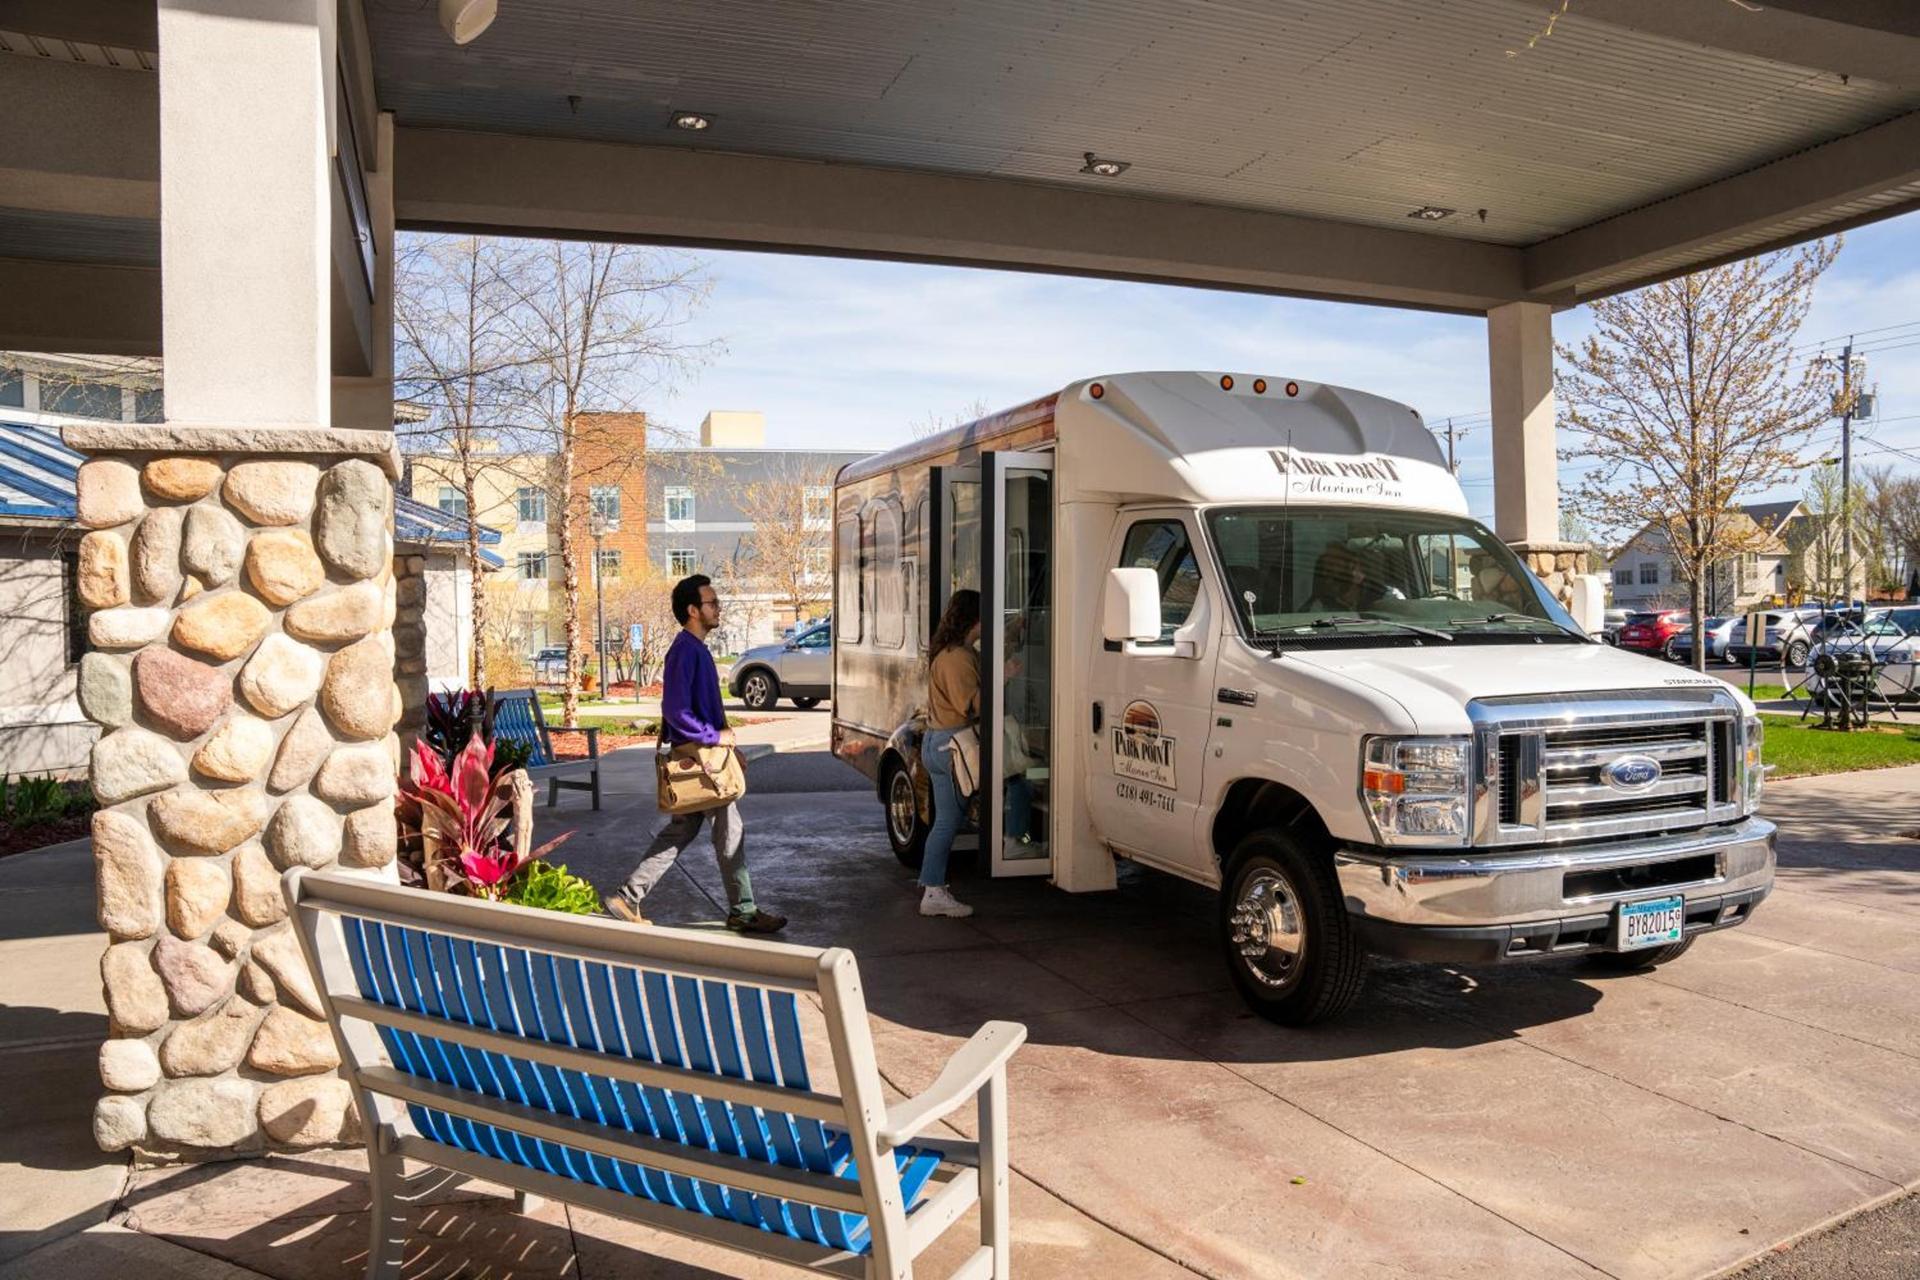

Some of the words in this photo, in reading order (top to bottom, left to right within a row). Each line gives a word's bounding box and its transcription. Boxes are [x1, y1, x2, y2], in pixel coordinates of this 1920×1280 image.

[1267, 449, 1336, 476] PARK
[1334, 457, 1400, 482] POINT
[1292, 477, 1363, 493] Marina
[1115, 730, 1140, 759] PARK
[1141, 739, 1172, 767] POINT
[1624, 764, 1650, 781] Ford
[1116, 782, 1138, 800] (218)
